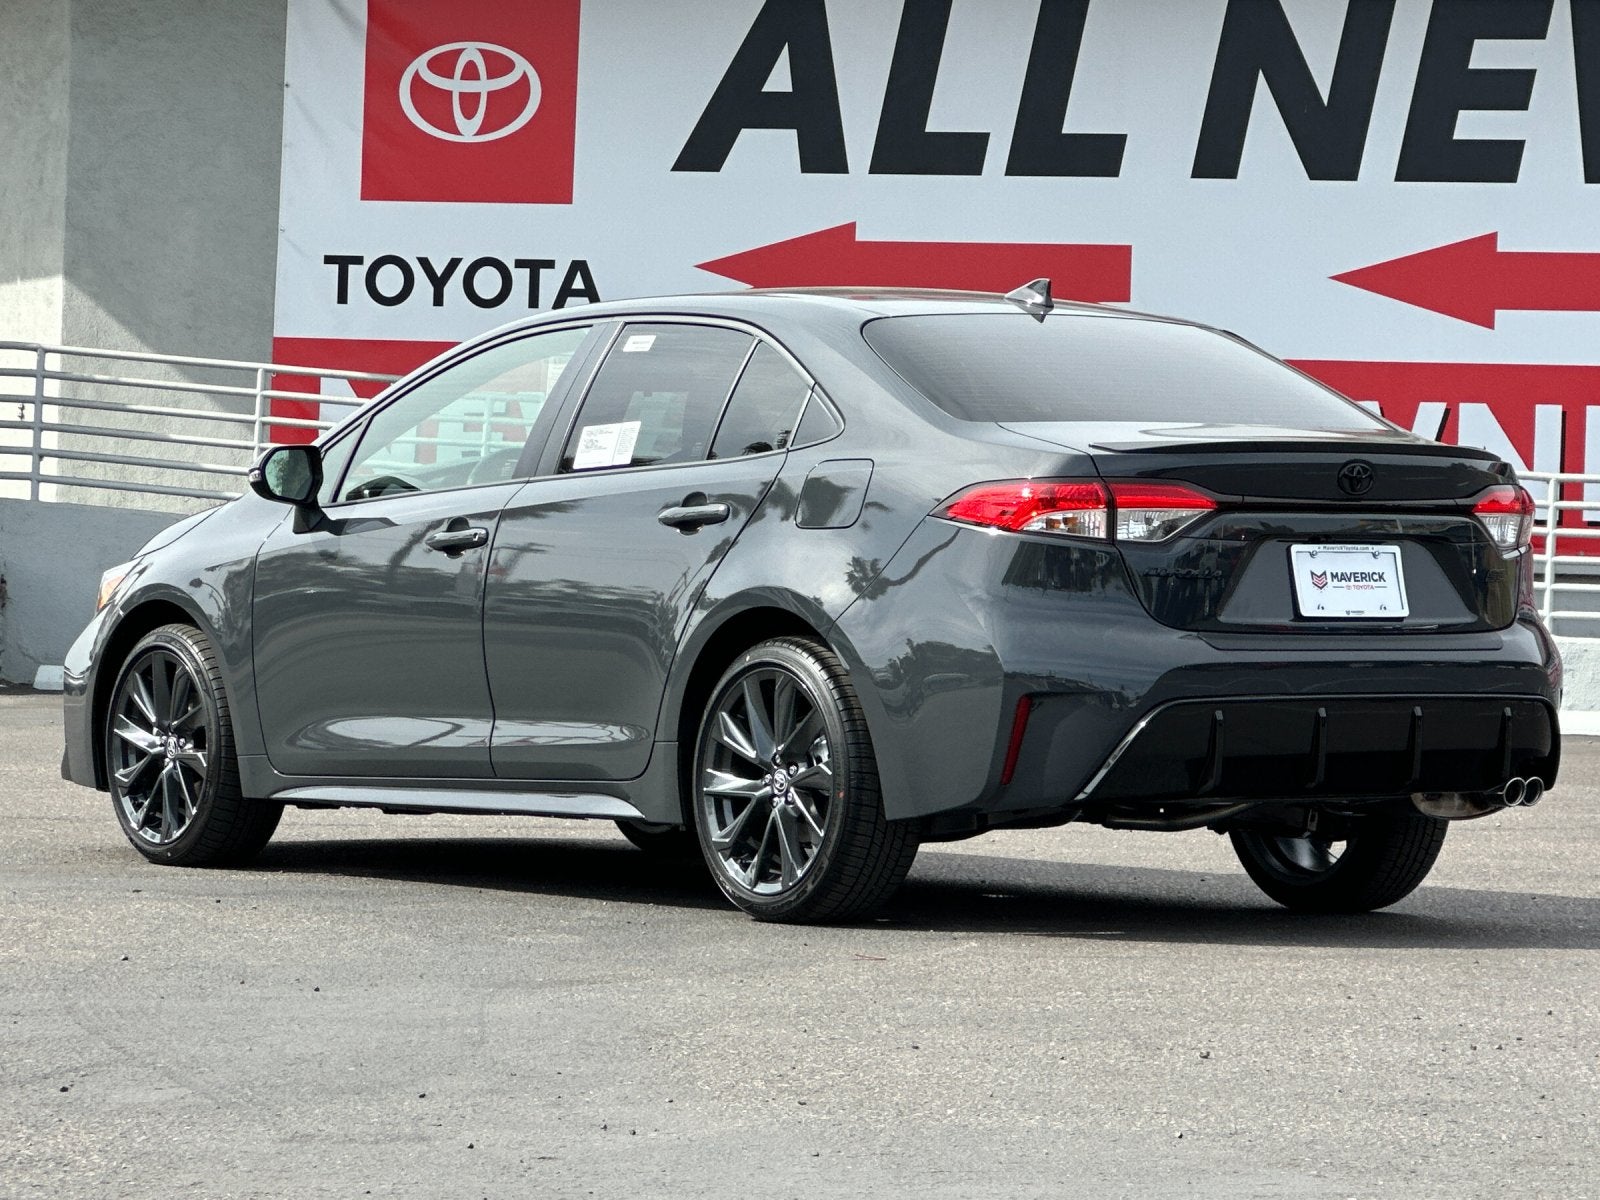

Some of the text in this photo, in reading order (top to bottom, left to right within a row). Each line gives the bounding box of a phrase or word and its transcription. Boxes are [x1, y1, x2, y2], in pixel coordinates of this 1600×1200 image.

[671, 0, 1600, 184] ALL NE
[323, 253, 602, 310] TOYOTA
[1330, 571, 1387, 583] MAVERICK
